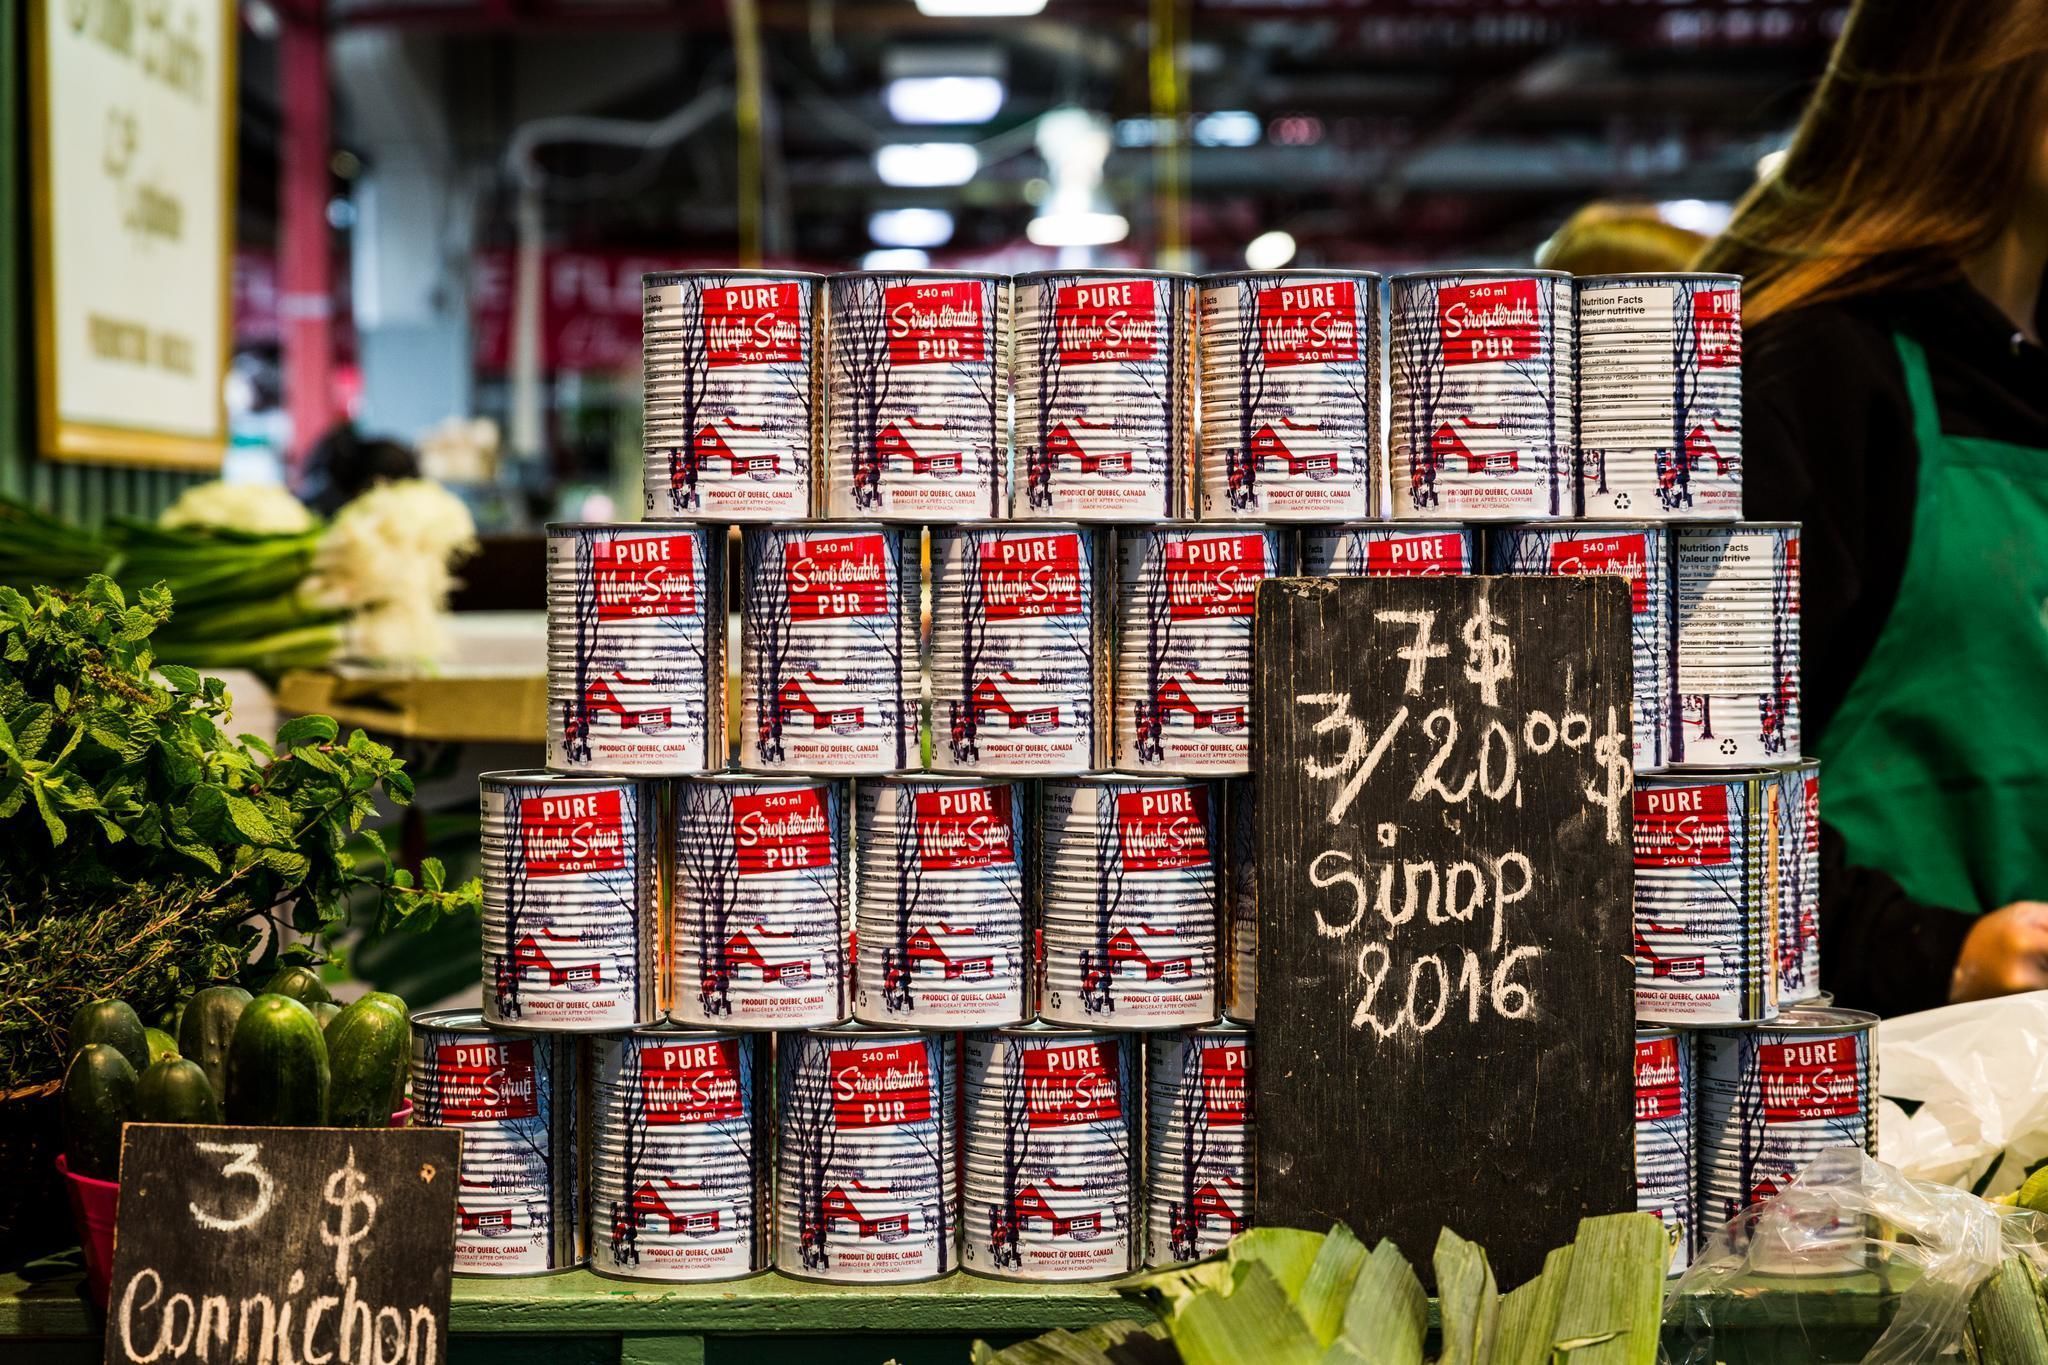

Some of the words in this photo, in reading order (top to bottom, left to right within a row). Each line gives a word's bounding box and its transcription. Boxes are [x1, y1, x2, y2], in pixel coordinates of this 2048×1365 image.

[725, 287, 779, 311] PURE
[917, 288, 938, 299] 540
[941, 289, 954, 298] ml
[1077, 285, 1132, 310] PURE
[1281, 286, 1335, 311] PURE
[1469, 287, 1491, 298] 540
[1494, 286, 1507, 296] ml
[1581, 296, 1615, 306] Nutrition
[1618, 295, 1643, 304] Facts
[892, 301, 937, 338] Sirop
[1445, 302, 1491, 337] Sirop
[1581, 307, 1605, 317] Valeur
[1607, 306, 1645, 316] nutritive
[710, 316, 753, 353] Maple
[1062, 314, 1103, 351] Maple
[1265, 317, 1309, 353] Maple
[742, 353, 762, 362] 540
[765, 351, 778, 360] ml
[917, 338, 960, 360] PUR
[1092, 350, 1113, 361] 540
[1116, 349, 1129, 358] ml
[1299, 352, 1319, 361] 540
[1322, 351, 1333, 359] ml
[1471, 337, 1515, 359] PUR
[615, 540, 671, 565] PURE
[816, 543, 838, 554] 540
[840, 542, 854, 552] ml
[1002, 539, 1058, 565] PURE
[1188, 540, 1243, 565] PURE
[1391, 539, 1444, 564] PURE
[1583, 542, 1604, 553] 540
[1607, 541, 1619, 551] ml
[1680, 544, 1721, 552] Nutrition
[1723, 544, 1749, 552] Facts
[1680, 555, 1709, 563] Valeur
[1711, 554, 1751, 562] nutritive
[791, 557, 837, 592] Sirop
[600, 569, 643, 606] Maple
[987, 570, 1030, 606] Maple
[1172, 570, 1216, 606] Maple
[631, 605, 653, 615] 540
[656, 604, 669, 613] ml
[818, 593, 861, 615] PUR
[1018, 605, 1040, 615] 540
[1042, 604, 1055, 613] ml
[1204, 605, 1225, 615] 540
[1228, 604, 1241, 613] ml
[542, 796, 598, 822] PURE
[765, 796, 787, 807] 540
[789, 794, 802, 804] ml
[939, 790, 993, 816] PURE
[1142, 791, 1192, 816] PURE
[1648, 790, 1703, 814] PURE
[740, 811, 786, 846] Sirop
[923, 820, 967, 857] Maple
[1125, 821, 1169, 858] Maple
[527, 826, 570, 863] Maple
[559, 862, 580, 872] 540
[584, 860, 597, 870] ml
[767, 846, 808, 868] PUR
[955, 856, 975, 866] 540
[978, 853, 991, 862] ml
[1157, 857, 1176, 867] 540
[1663, 855, 1684, 865] 540
[1688, 855, 1701, 865] ml
[1351, 941, 1542, 1040] 2016
[456, 1045, 509, 1068] PURE
[664, 1045, 718, 1071] PURE
[862, 1052, 883, 1063] 540
[887, 1050, 899, 1060] ml
[1047, 1046, 1100, 1072] PURE
[1641, 1046, 1653, 1056] ml
[1783, 1042, 1838, 1068] PURE
[443, 1074, 482, 1109] Maple
[648, 1076, 692, 1111] Maple
[837, 1066, 883, 1101] Sirop
[1031, 1078, 1074, 1113] Maple
[1767, 1073, 1811, 1108] Maple
[471, 1109, 492, 1119] 540
[495, 1108, 508, 1117] ml
[679, 1111, 701, 1122] 540
[704, 1108, 716, 1119] ml
[863, 1101, 906, 1124] PUR
[1063, 1112, 1083, 1123] 540
[1086, 1110, 1099, 1120] ml
[1637, 1096, 1659, 1118] UR
[1799, 1108, 1821, 1119] 540
[1823, 1107, 1836, 1116] ml
[190, 1142, 275, 1231] 3
[319, 1143, 379, 1287] $
[902, 1250, 923, 1258] CANADA
[1093, 1248, 1113, 1256] CANADA
[119, 1268, 439, 1365] Cornichon
